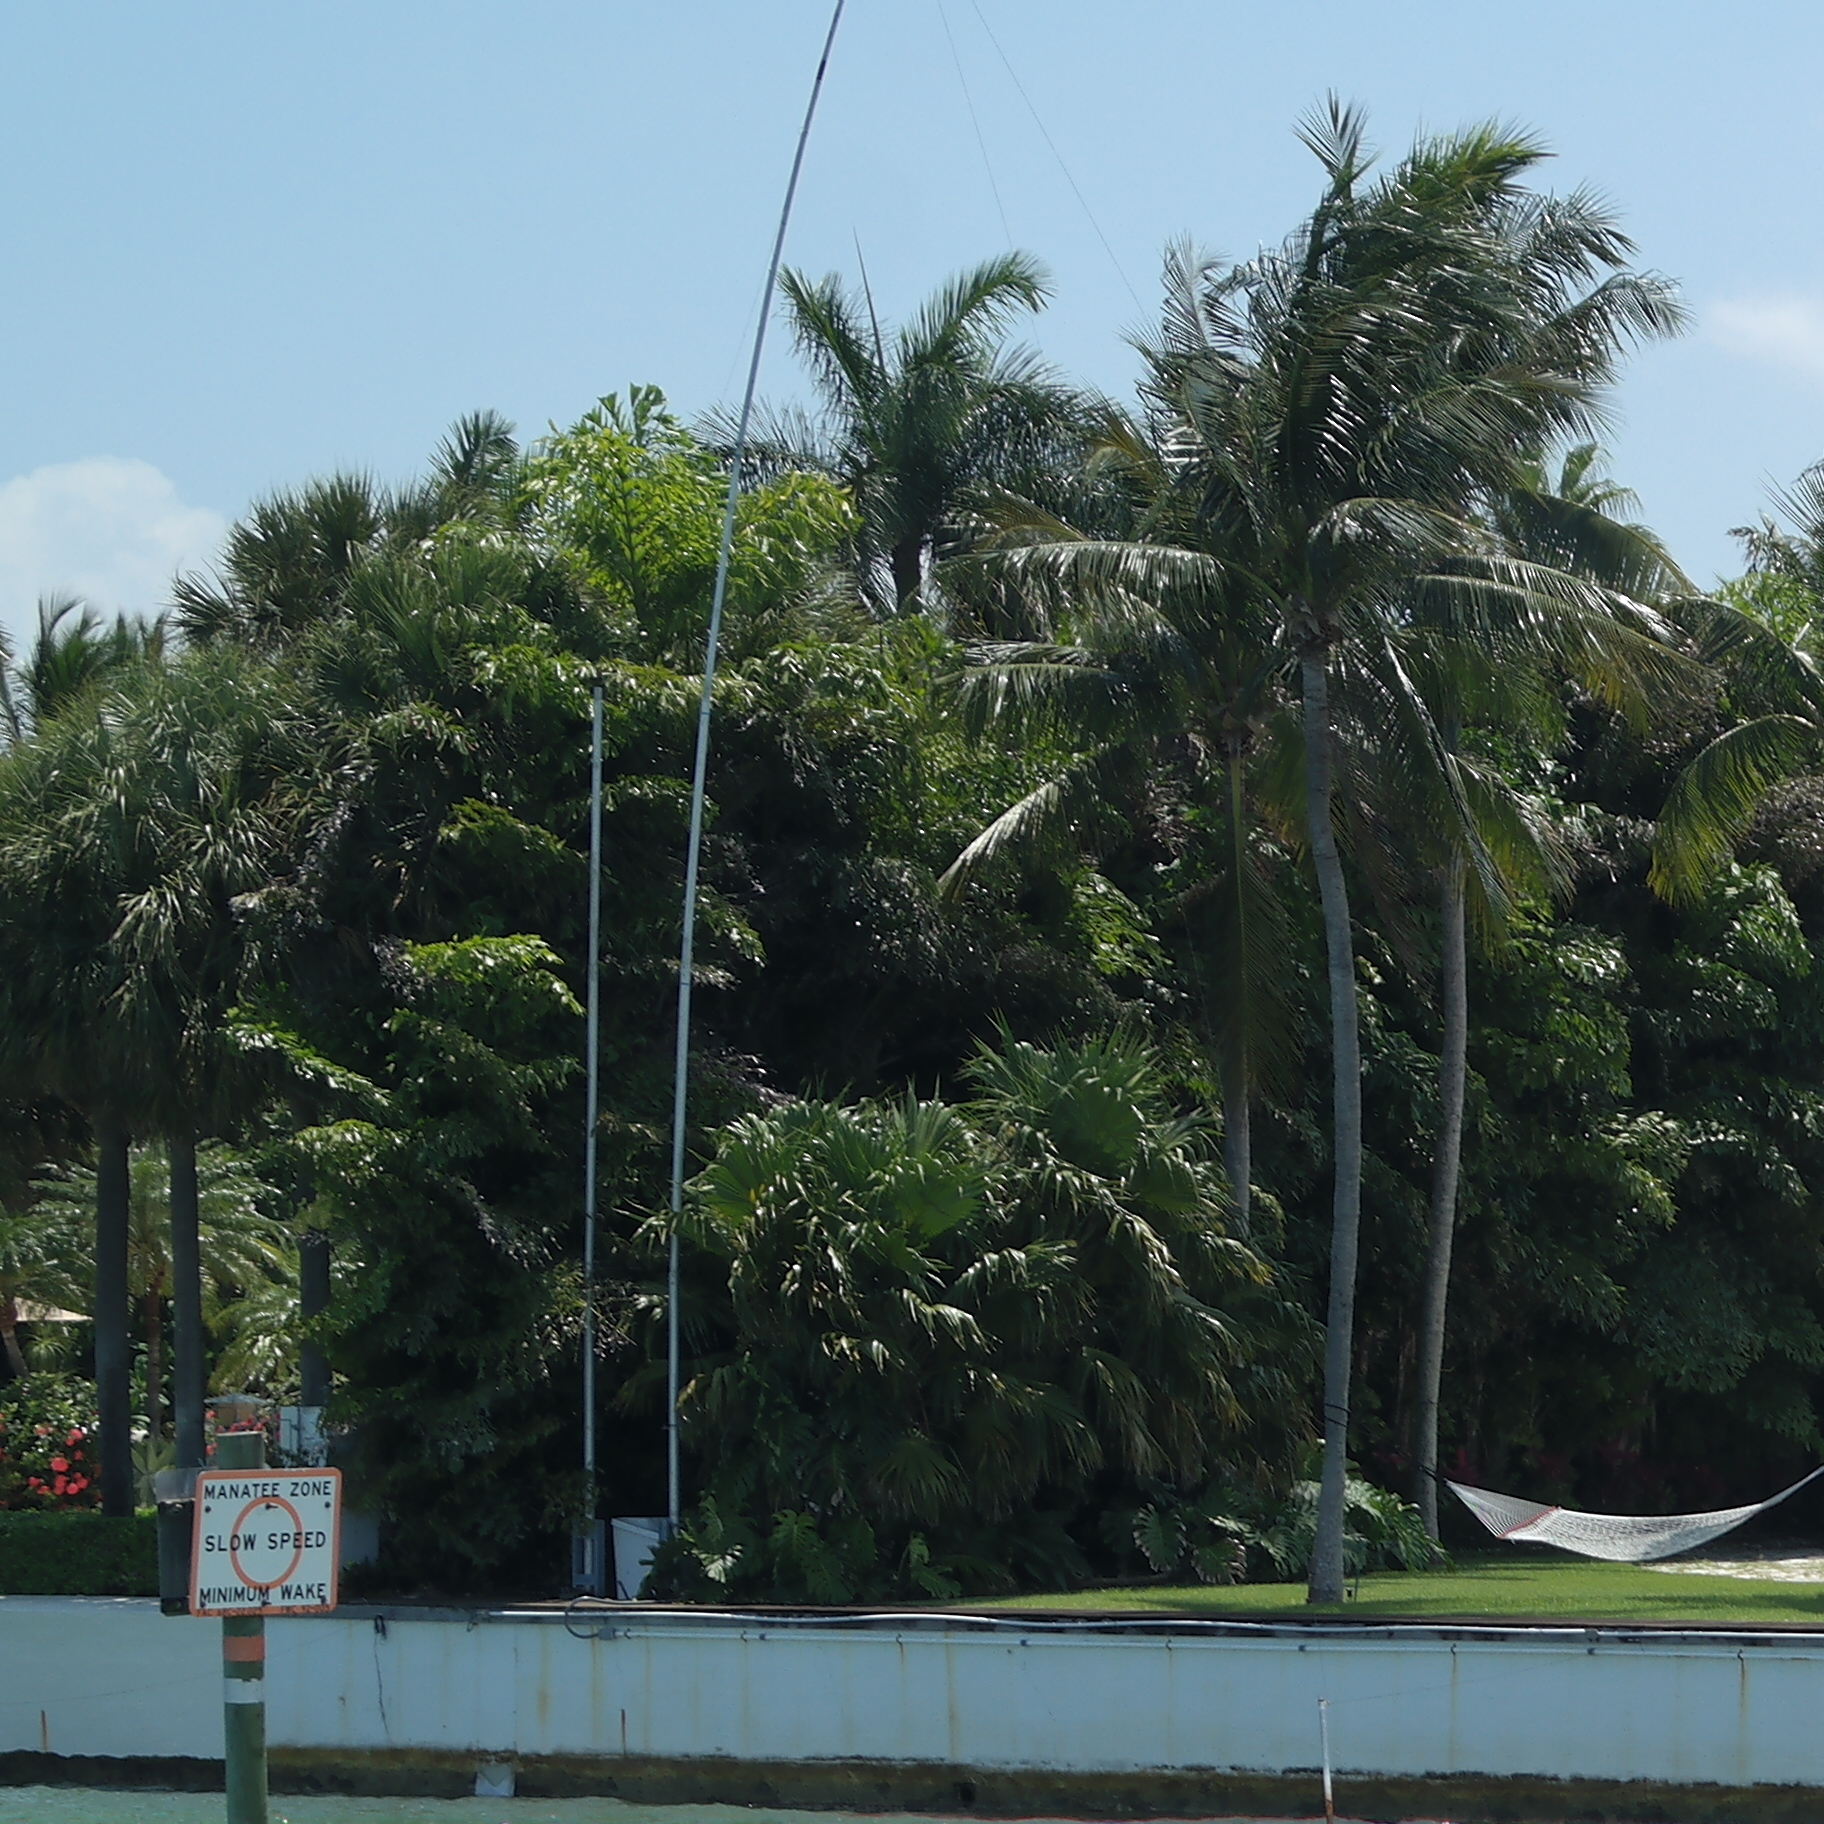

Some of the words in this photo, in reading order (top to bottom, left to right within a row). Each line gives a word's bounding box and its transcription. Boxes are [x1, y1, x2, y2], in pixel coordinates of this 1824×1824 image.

[204, 1483, 280, 1500] MANATEE
[290, 1481, 332, 1497] ZONE
[204, 1534, 257, 1552] SLOW
[267, 1531, 327, 1550] SPEED
[200, 1586, 270, 1604] MINIMUM
[280, 1583, 327, 1601] WAKE
